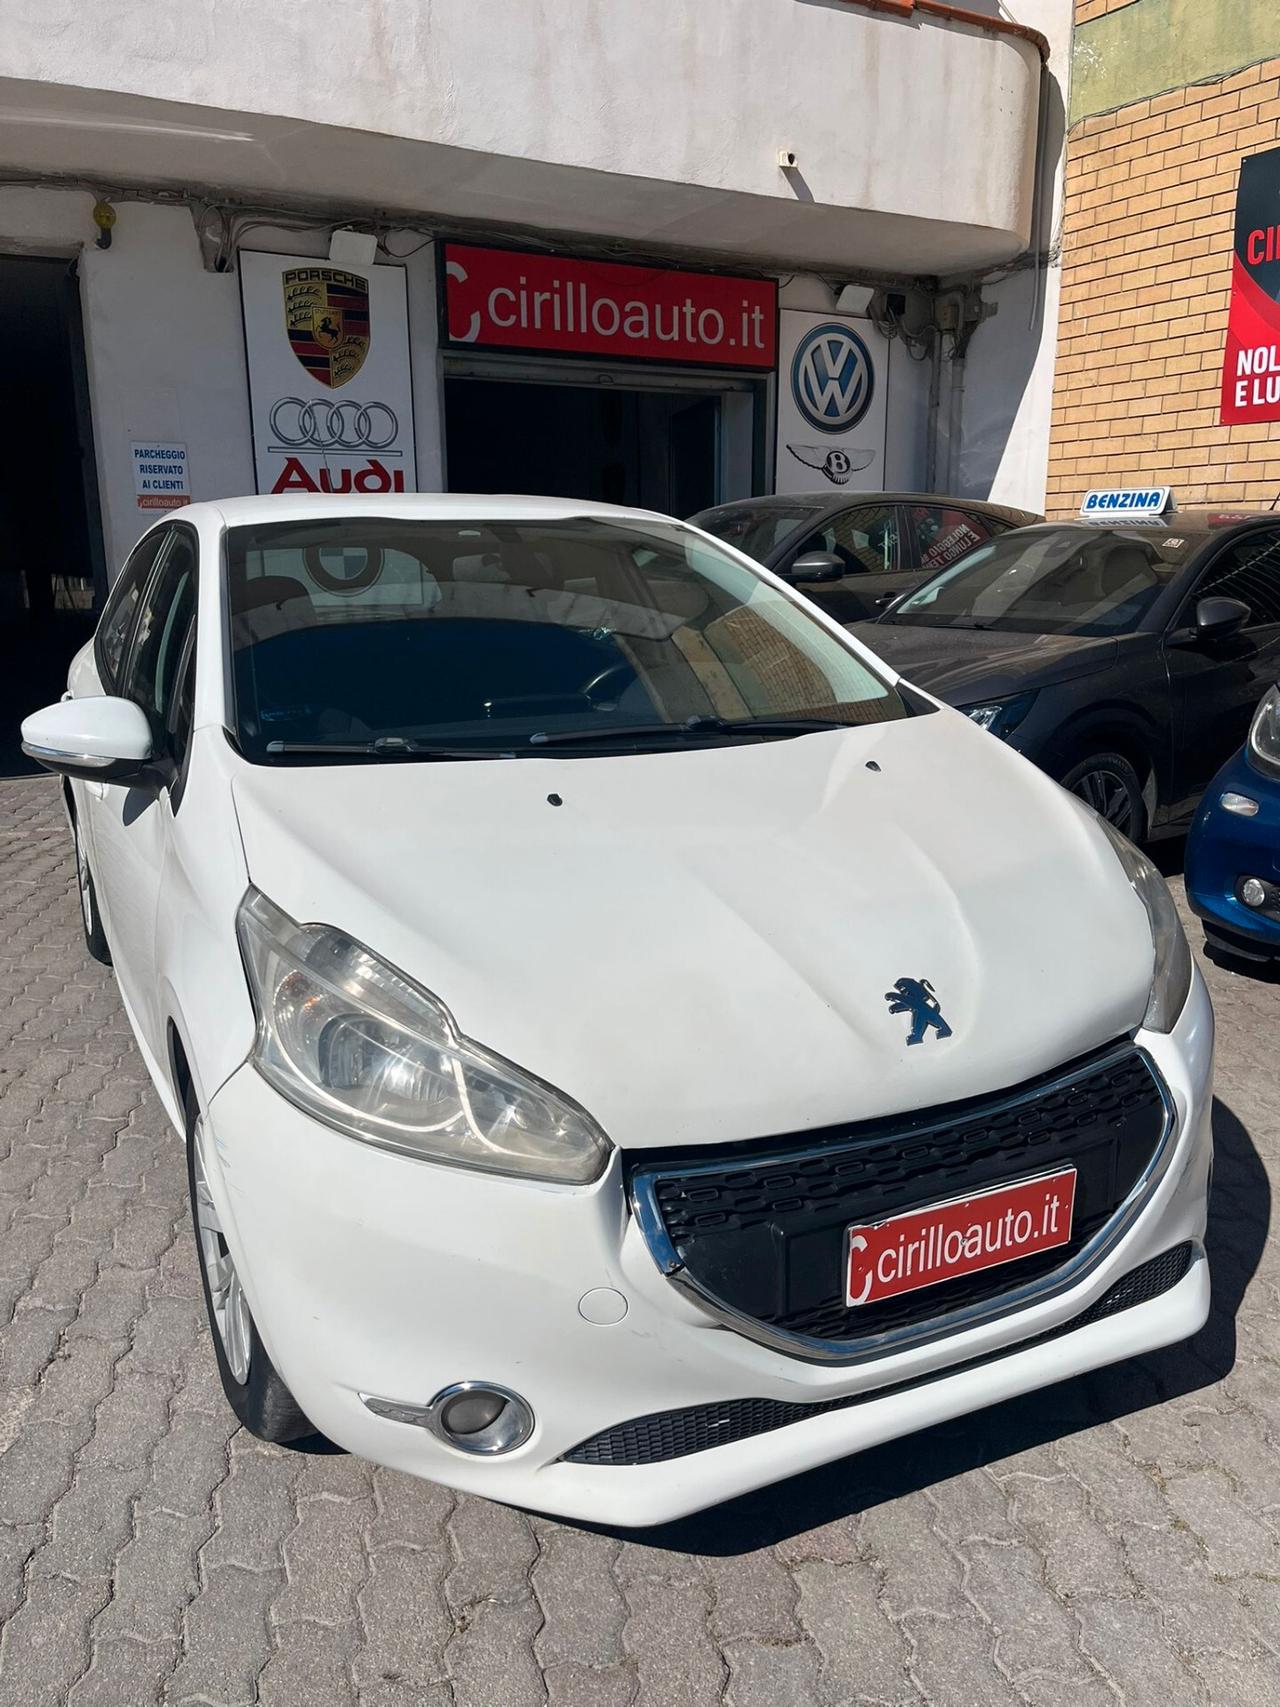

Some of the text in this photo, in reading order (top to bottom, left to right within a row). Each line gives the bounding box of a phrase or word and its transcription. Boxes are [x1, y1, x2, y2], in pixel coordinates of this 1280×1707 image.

[285, 270, 368, 291] PORSCHE
[487, 276, 765, 349] cirilloauto.it
[1236, 345, 1280, 377] NOL
[1235, 380, 1248, 407] E
[134, 448, 186, 460] PARCHEGGIO
[139, 464, 184, 475] RISERVATO
[142, 480, 184, 490] AI CLIENTI
[1086, 491, 1161, 509] BENZINA
[877, 1193, 1060, 1284] cirilloauto.it
